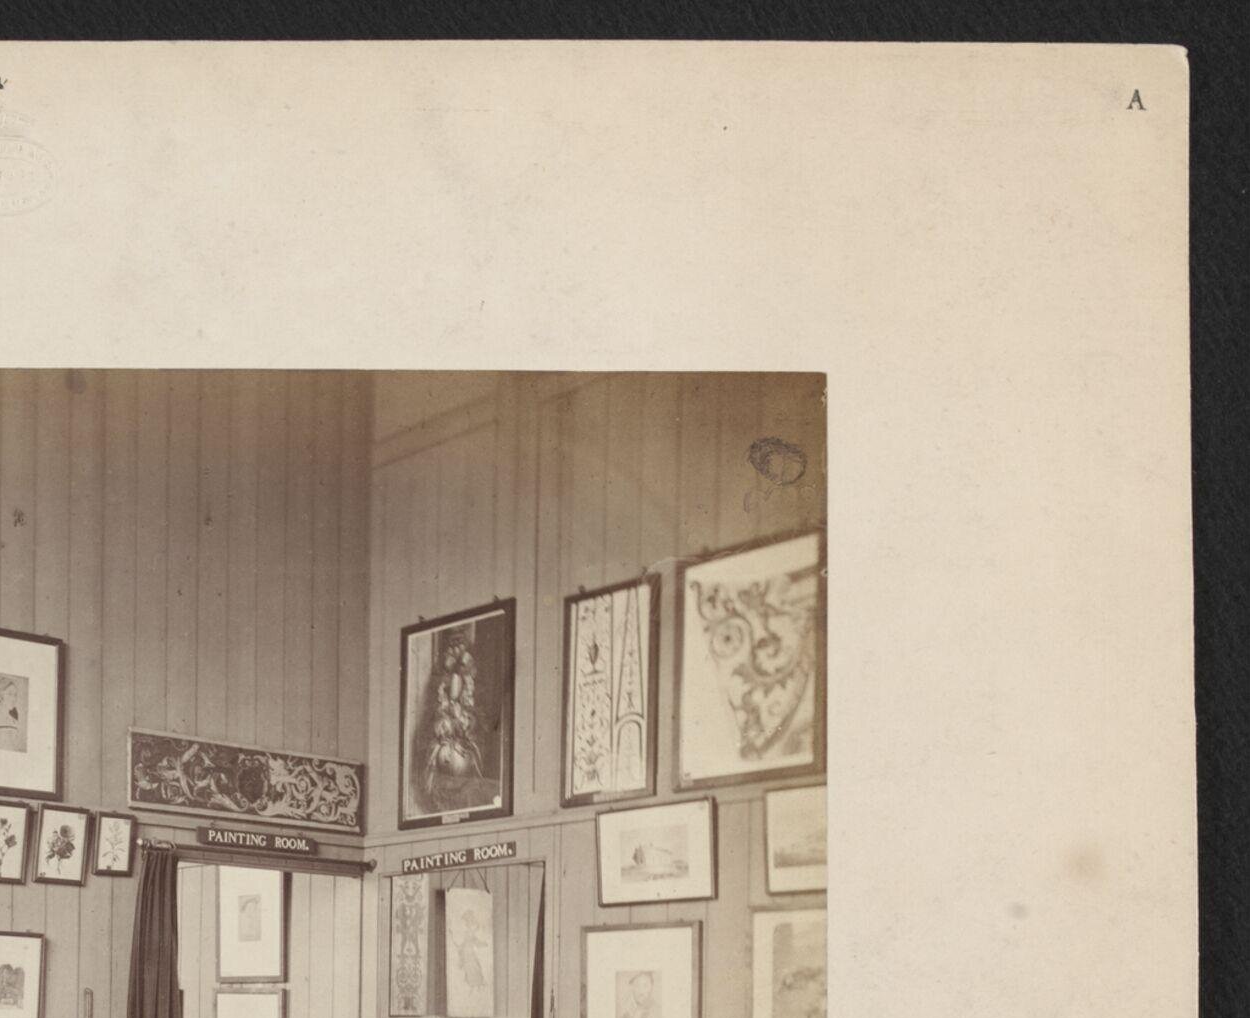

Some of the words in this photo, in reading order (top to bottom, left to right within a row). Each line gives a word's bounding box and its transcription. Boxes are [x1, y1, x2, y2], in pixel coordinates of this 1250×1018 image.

[1126, 89, 1146, 111] A
[208, 830, 267, 847] PAINTING
[274, 836, 310, 851] ROOM.
[403, 851, 467, 873] PAINTING
[473, 844, 513, 861] ROOM.
